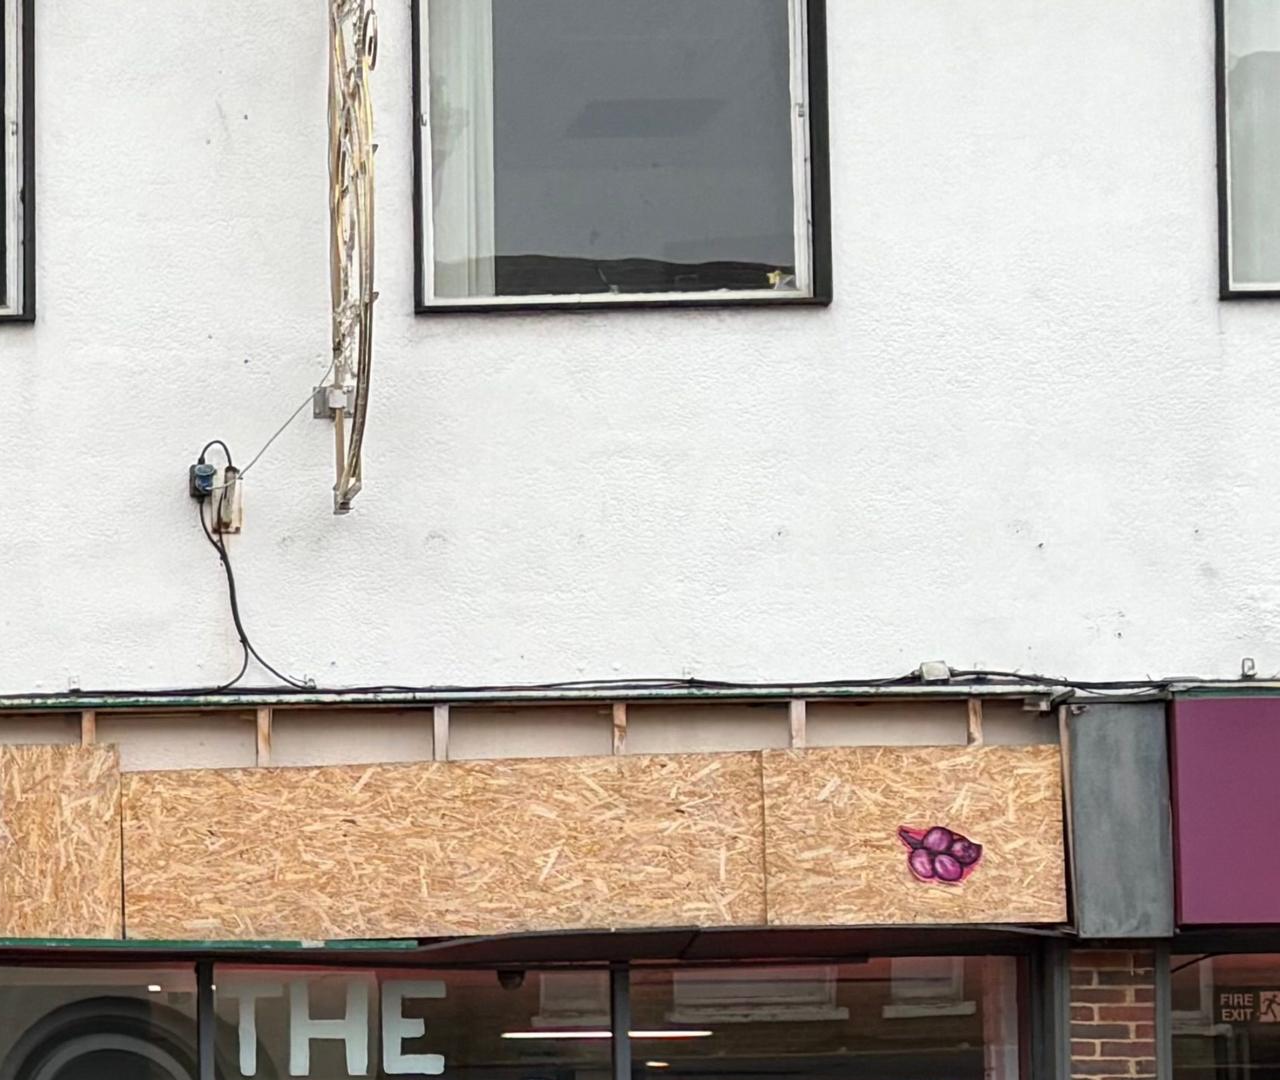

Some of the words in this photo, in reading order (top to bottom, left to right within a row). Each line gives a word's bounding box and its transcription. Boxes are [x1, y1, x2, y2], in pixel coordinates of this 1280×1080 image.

[1220, 993, 1254, 1006] FIRE
[1222, 1008, 1254, 1022] EXIT
[213, 980, 447, 1076] THE
